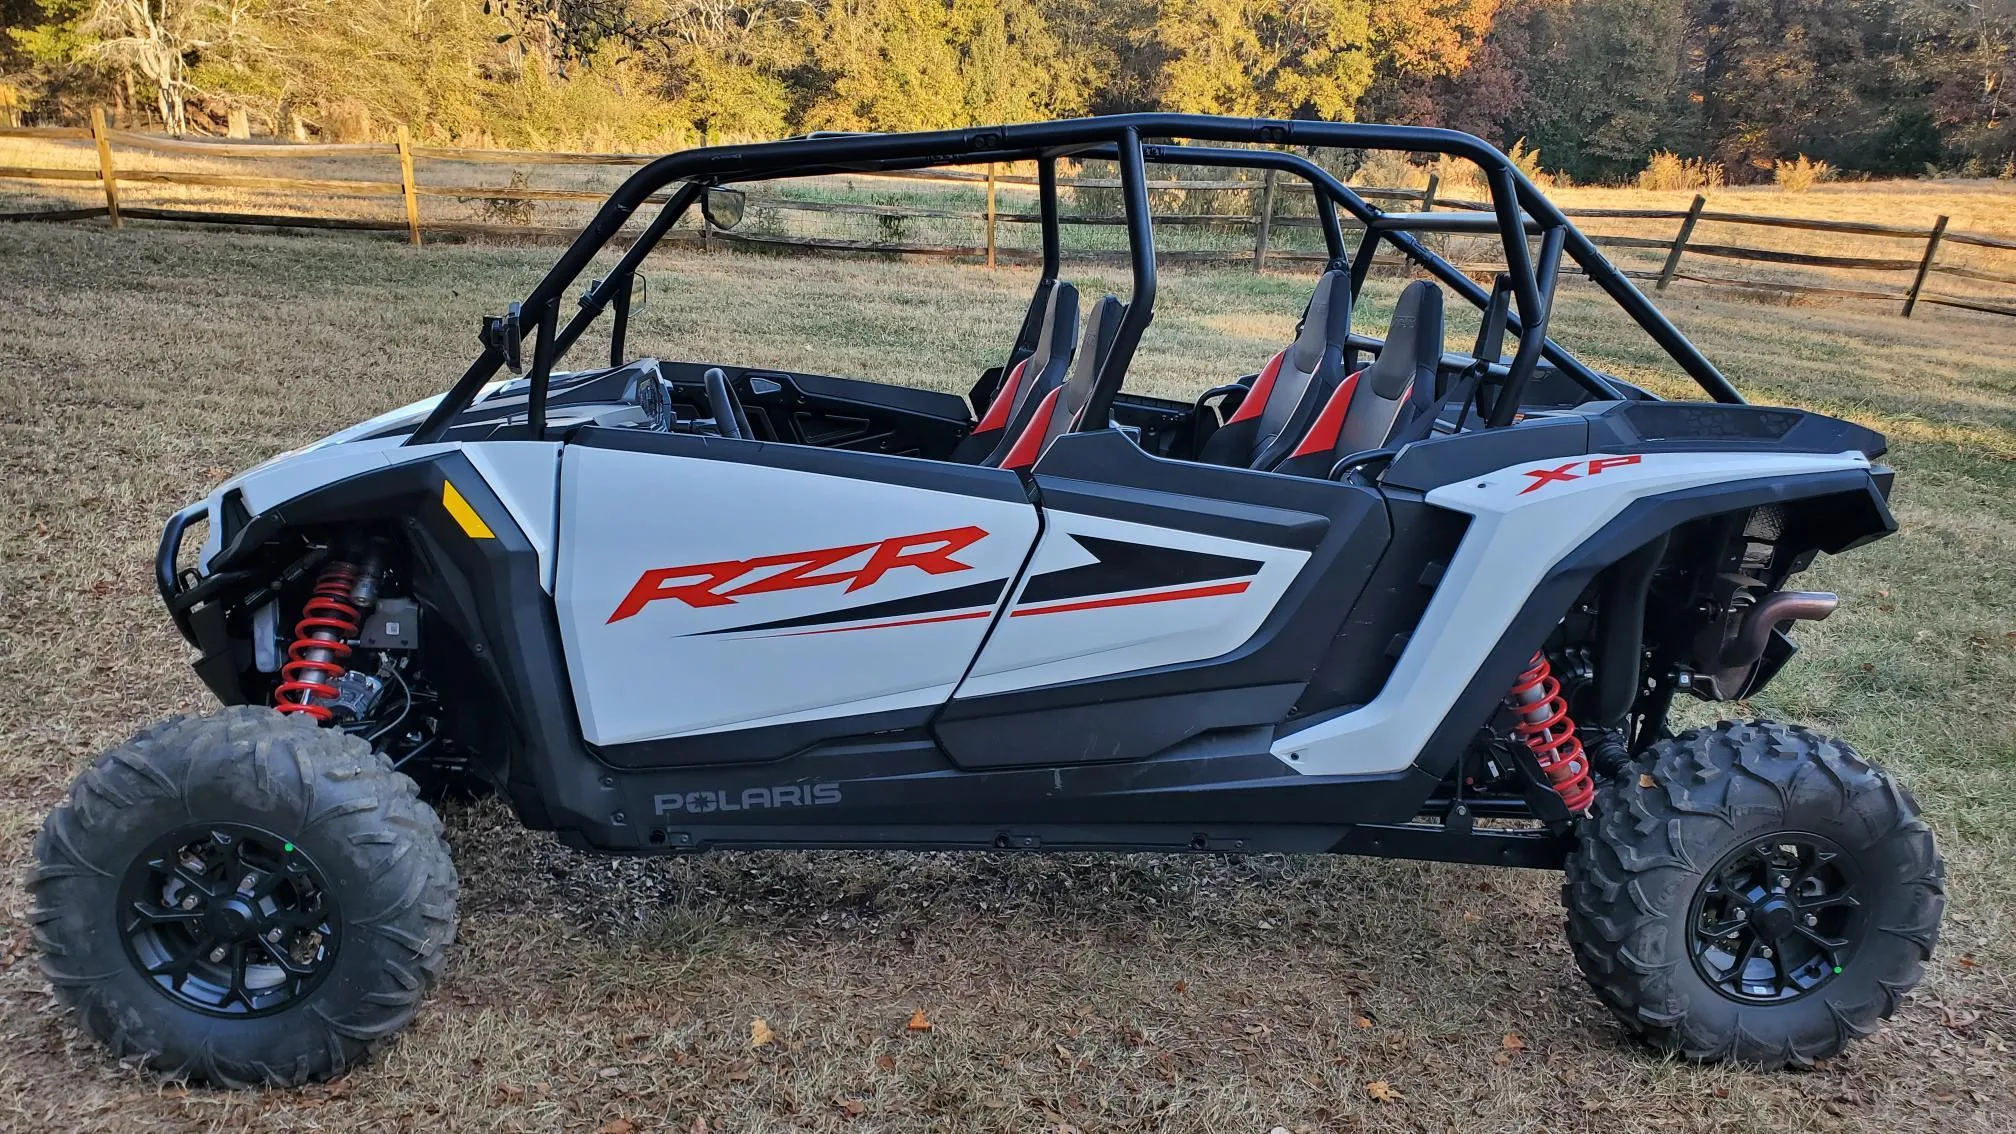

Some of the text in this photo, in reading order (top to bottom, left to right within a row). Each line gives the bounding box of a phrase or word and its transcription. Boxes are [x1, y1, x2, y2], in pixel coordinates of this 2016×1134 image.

[1515, 455, 1642, 496] XP
[606, 526, 990, 625] RZR
[654, 783, 842, 816] POLARIS
